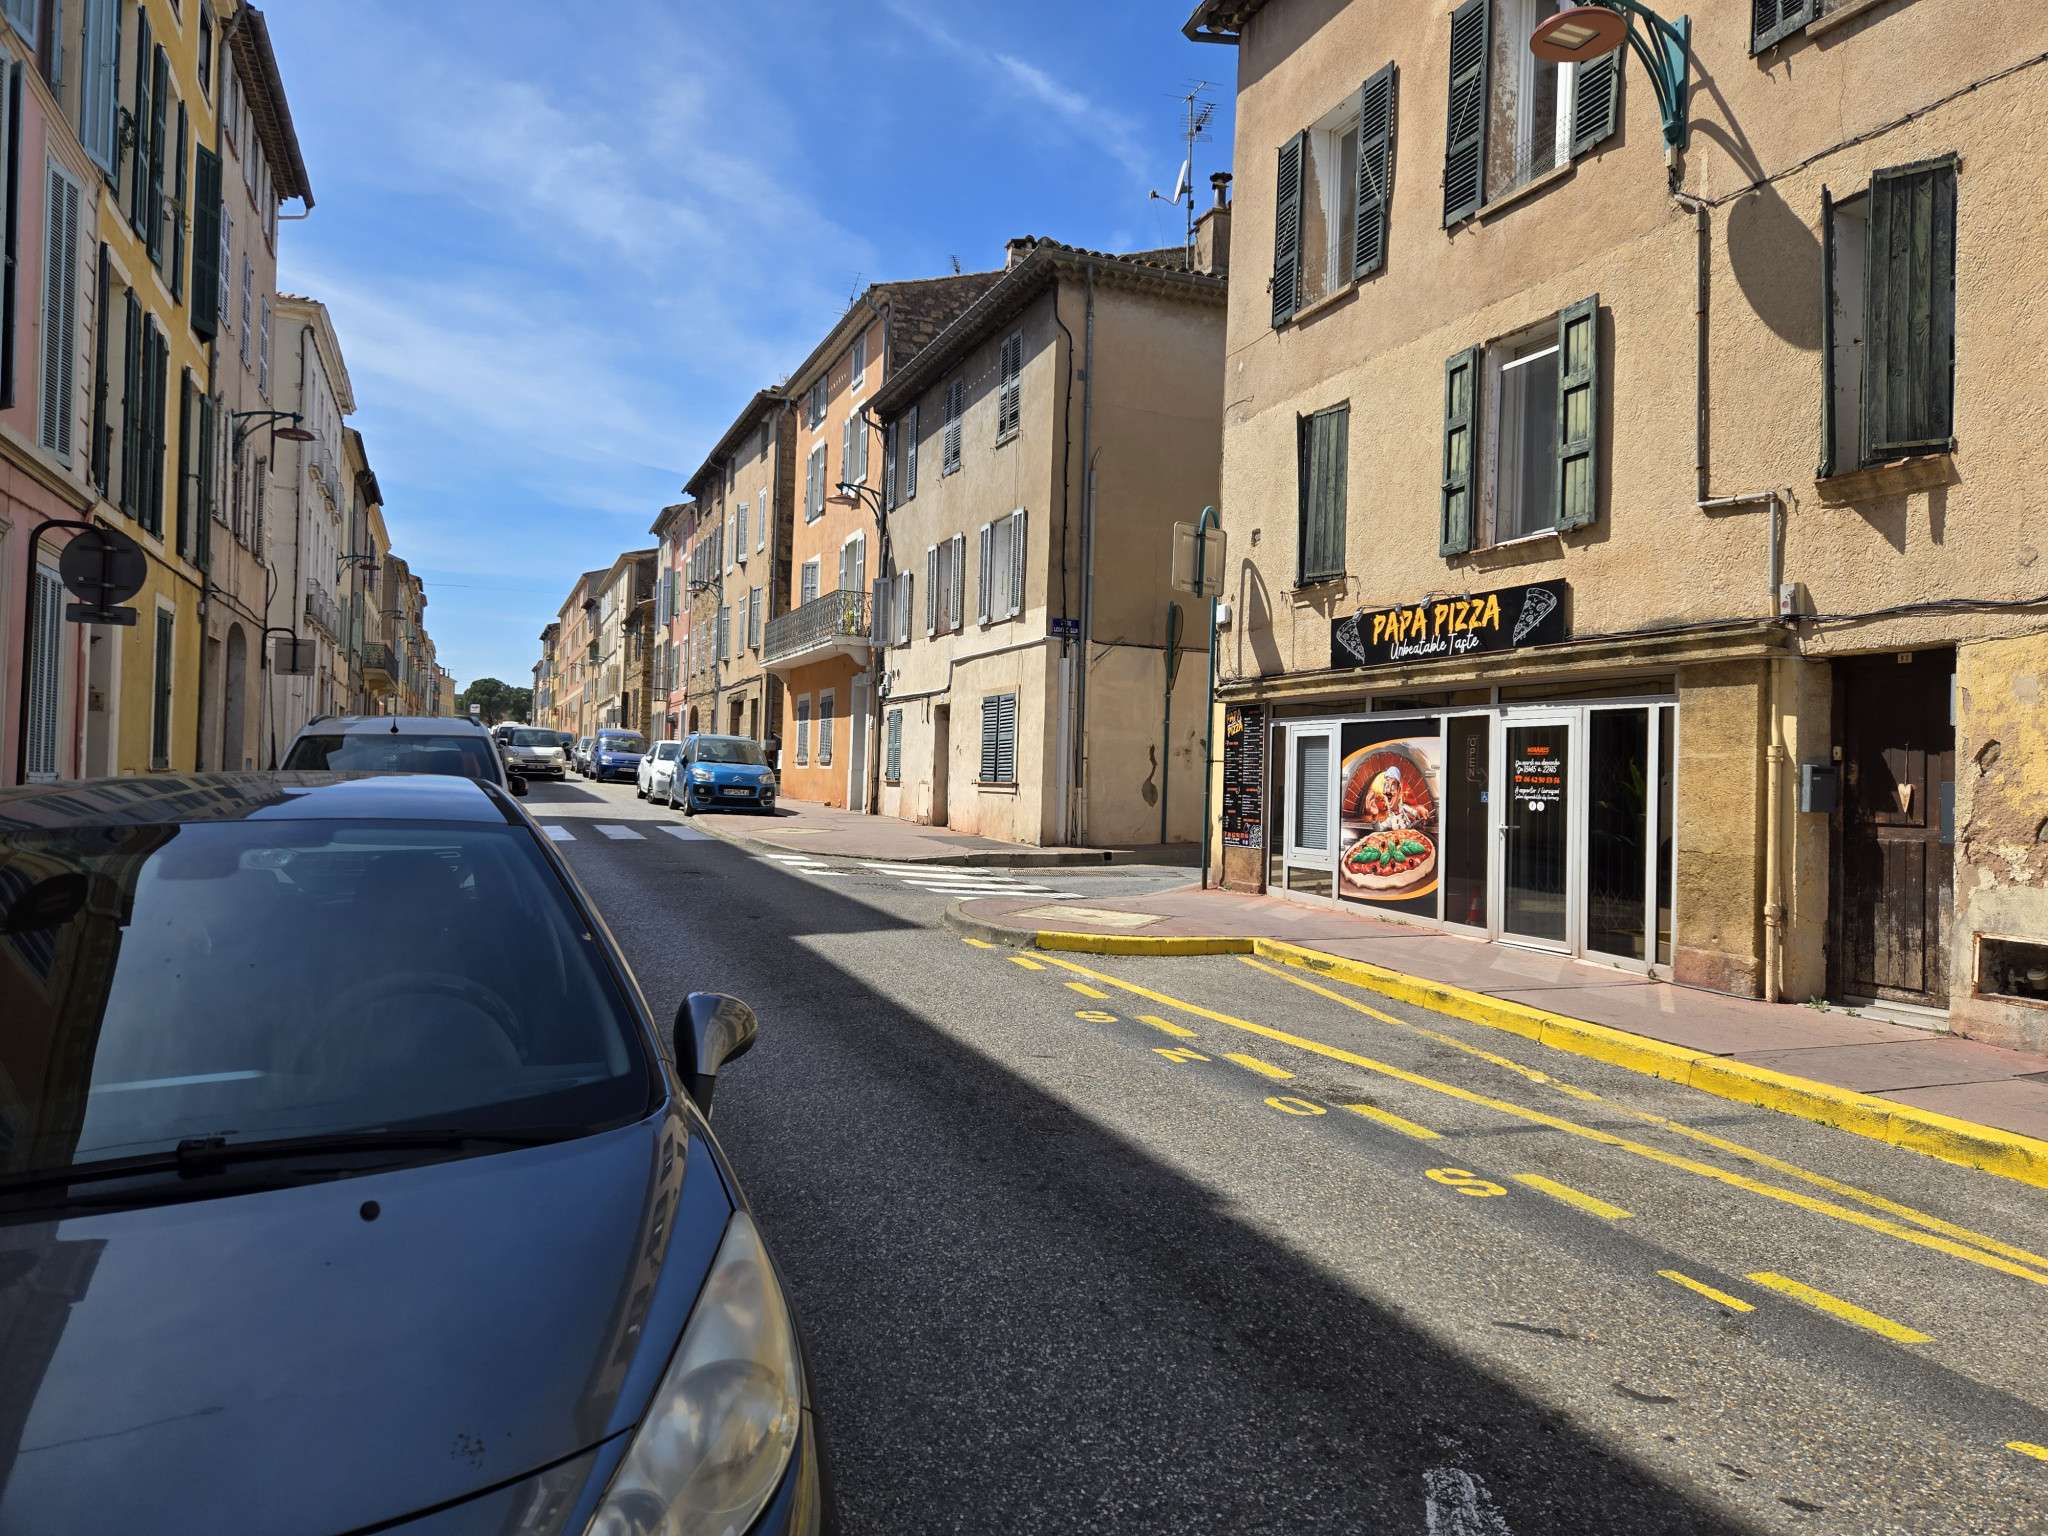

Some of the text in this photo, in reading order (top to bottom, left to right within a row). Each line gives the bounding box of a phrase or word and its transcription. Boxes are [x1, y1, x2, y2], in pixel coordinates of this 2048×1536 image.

[1373, 594, 1501, 645] PAPA PIZZA
[1390, 629, 1479, 659] Unbeatable Taste
